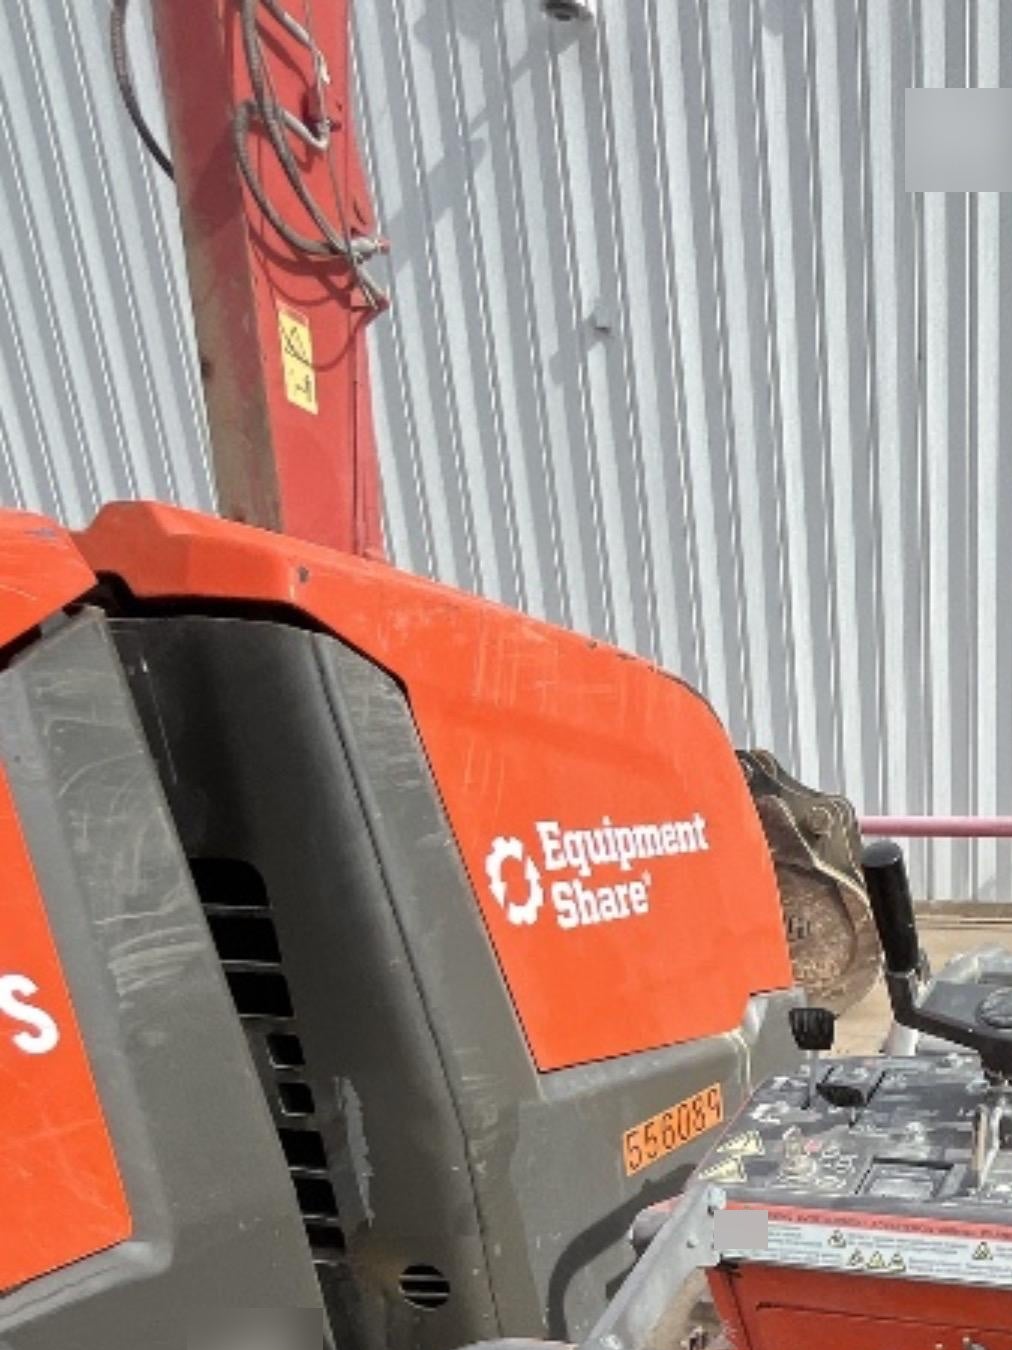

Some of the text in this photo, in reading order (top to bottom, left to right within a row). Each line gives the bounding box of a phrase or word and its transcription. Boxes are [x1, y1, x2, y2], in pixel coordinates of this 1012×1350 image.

[534, 812, 708, 877] Equipment
[551, 876, 650, 929] Share
[626, 1088, 721, 1170] 556089
